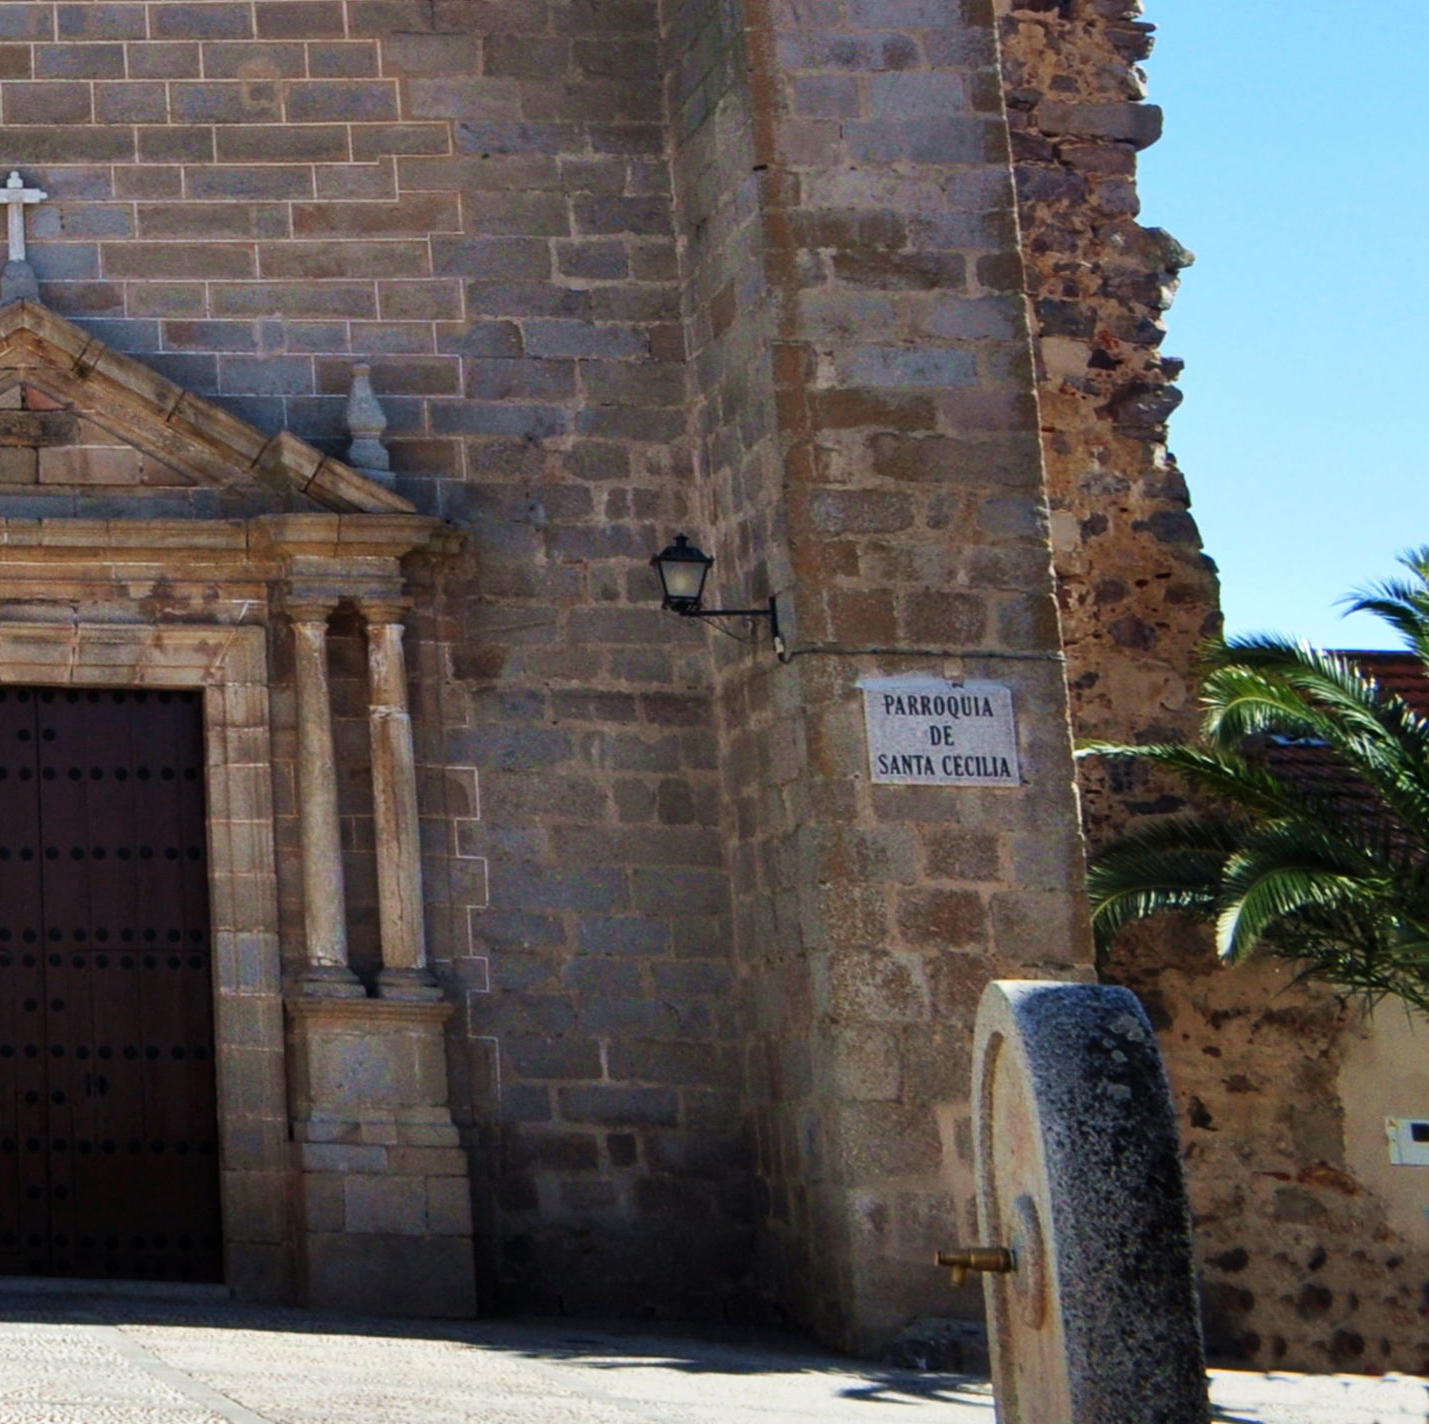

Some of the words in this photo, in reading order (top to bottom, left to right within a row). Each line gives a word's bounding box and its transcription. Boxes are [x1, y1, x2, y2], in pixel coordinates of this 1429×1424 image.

[883, 693, 994, 719] PARROQUIA
[929, 725, 955, 746] DE
[877, 753, 935, 776] SANTA
[942, 755, 1012, 778] CECILIA
